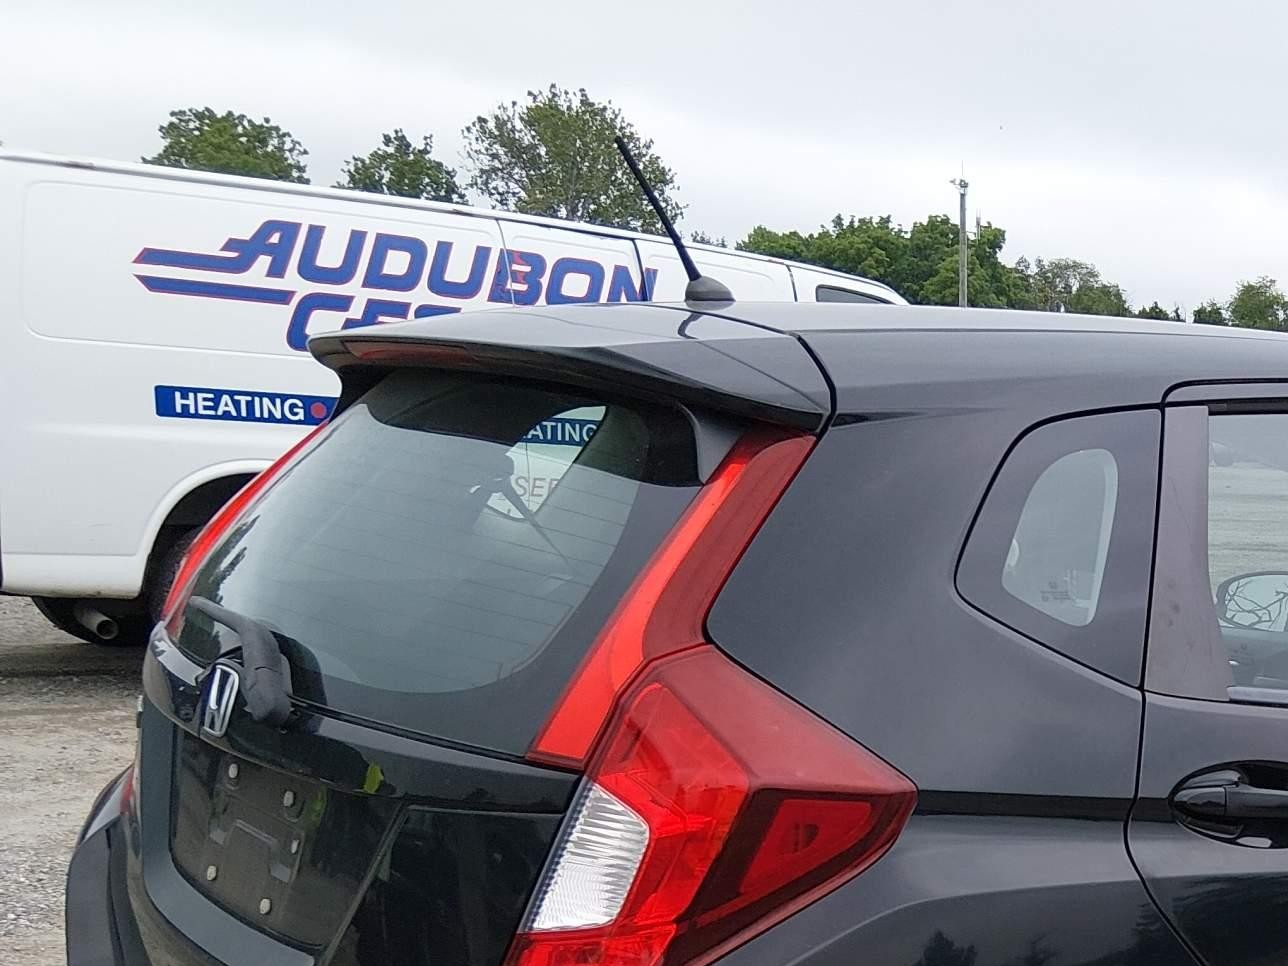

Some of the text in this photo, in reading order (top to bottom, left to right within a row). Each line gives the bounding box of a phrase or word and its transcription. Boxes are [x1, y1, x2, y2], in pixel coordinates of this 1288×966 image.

[132, 219, 658, 306] AUDUBON
[174, 391, 304, 421] HEATING
[523, 421, 598, 442] ATING
